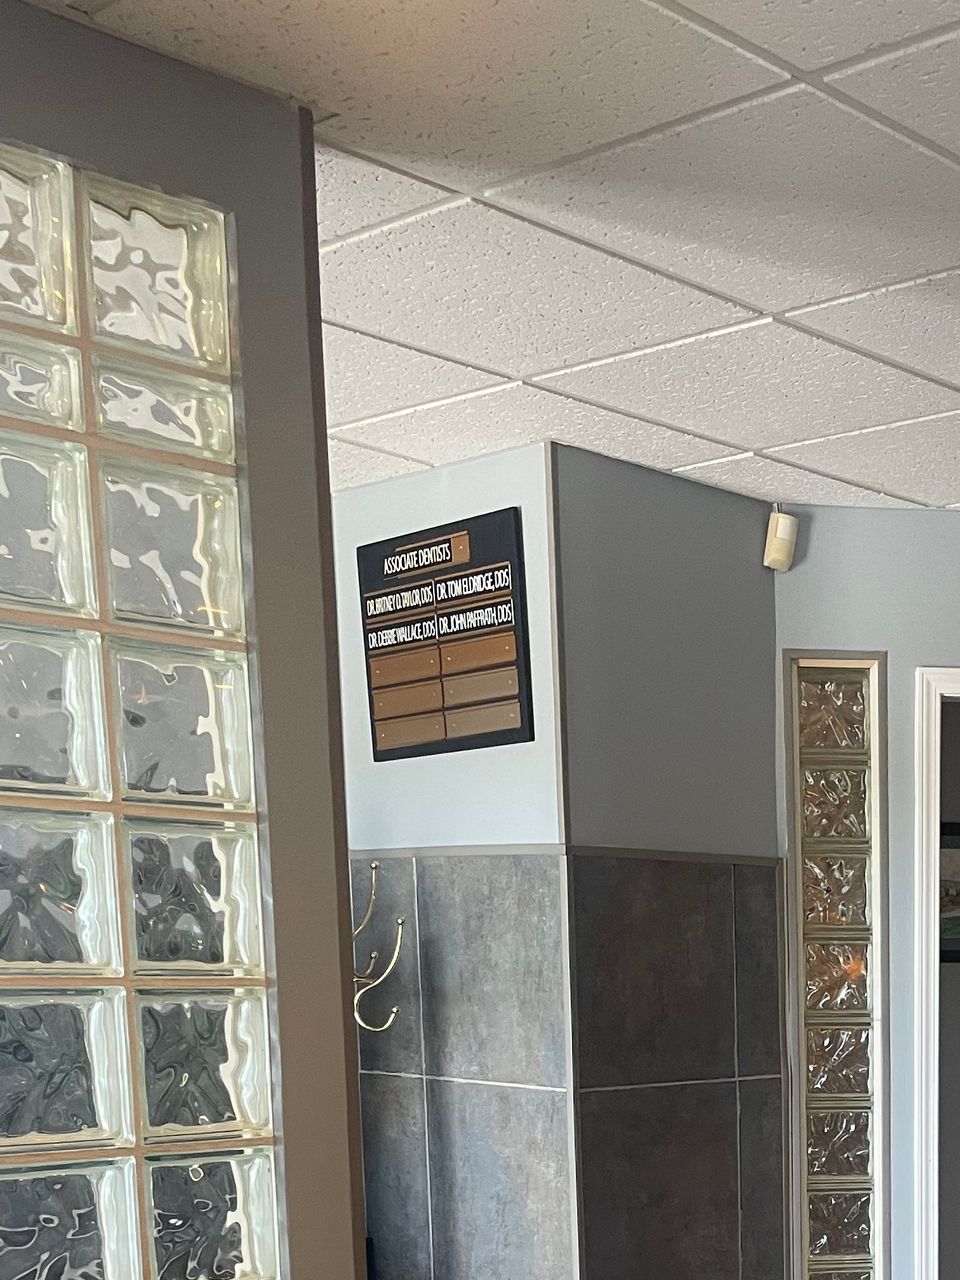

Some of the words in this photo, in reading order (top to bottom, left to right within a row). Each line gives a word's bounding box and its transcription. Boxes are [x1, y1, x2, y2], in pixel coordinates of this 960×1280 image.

[384, 551, 418, 574] ASSOCIATE
[418, 543, 451, 566] DENTISTS
[420, 586, 433, 604] DDS
[447, 579, 462, 598] TOM
[494, 569, 510, 589] DDS
[448, 613, 467, 632] JOHN
[497, 603, 512, 623] DDS
[377, 628, 398, 647] DEBBIE
[422, 620, 436, 638] DDS
